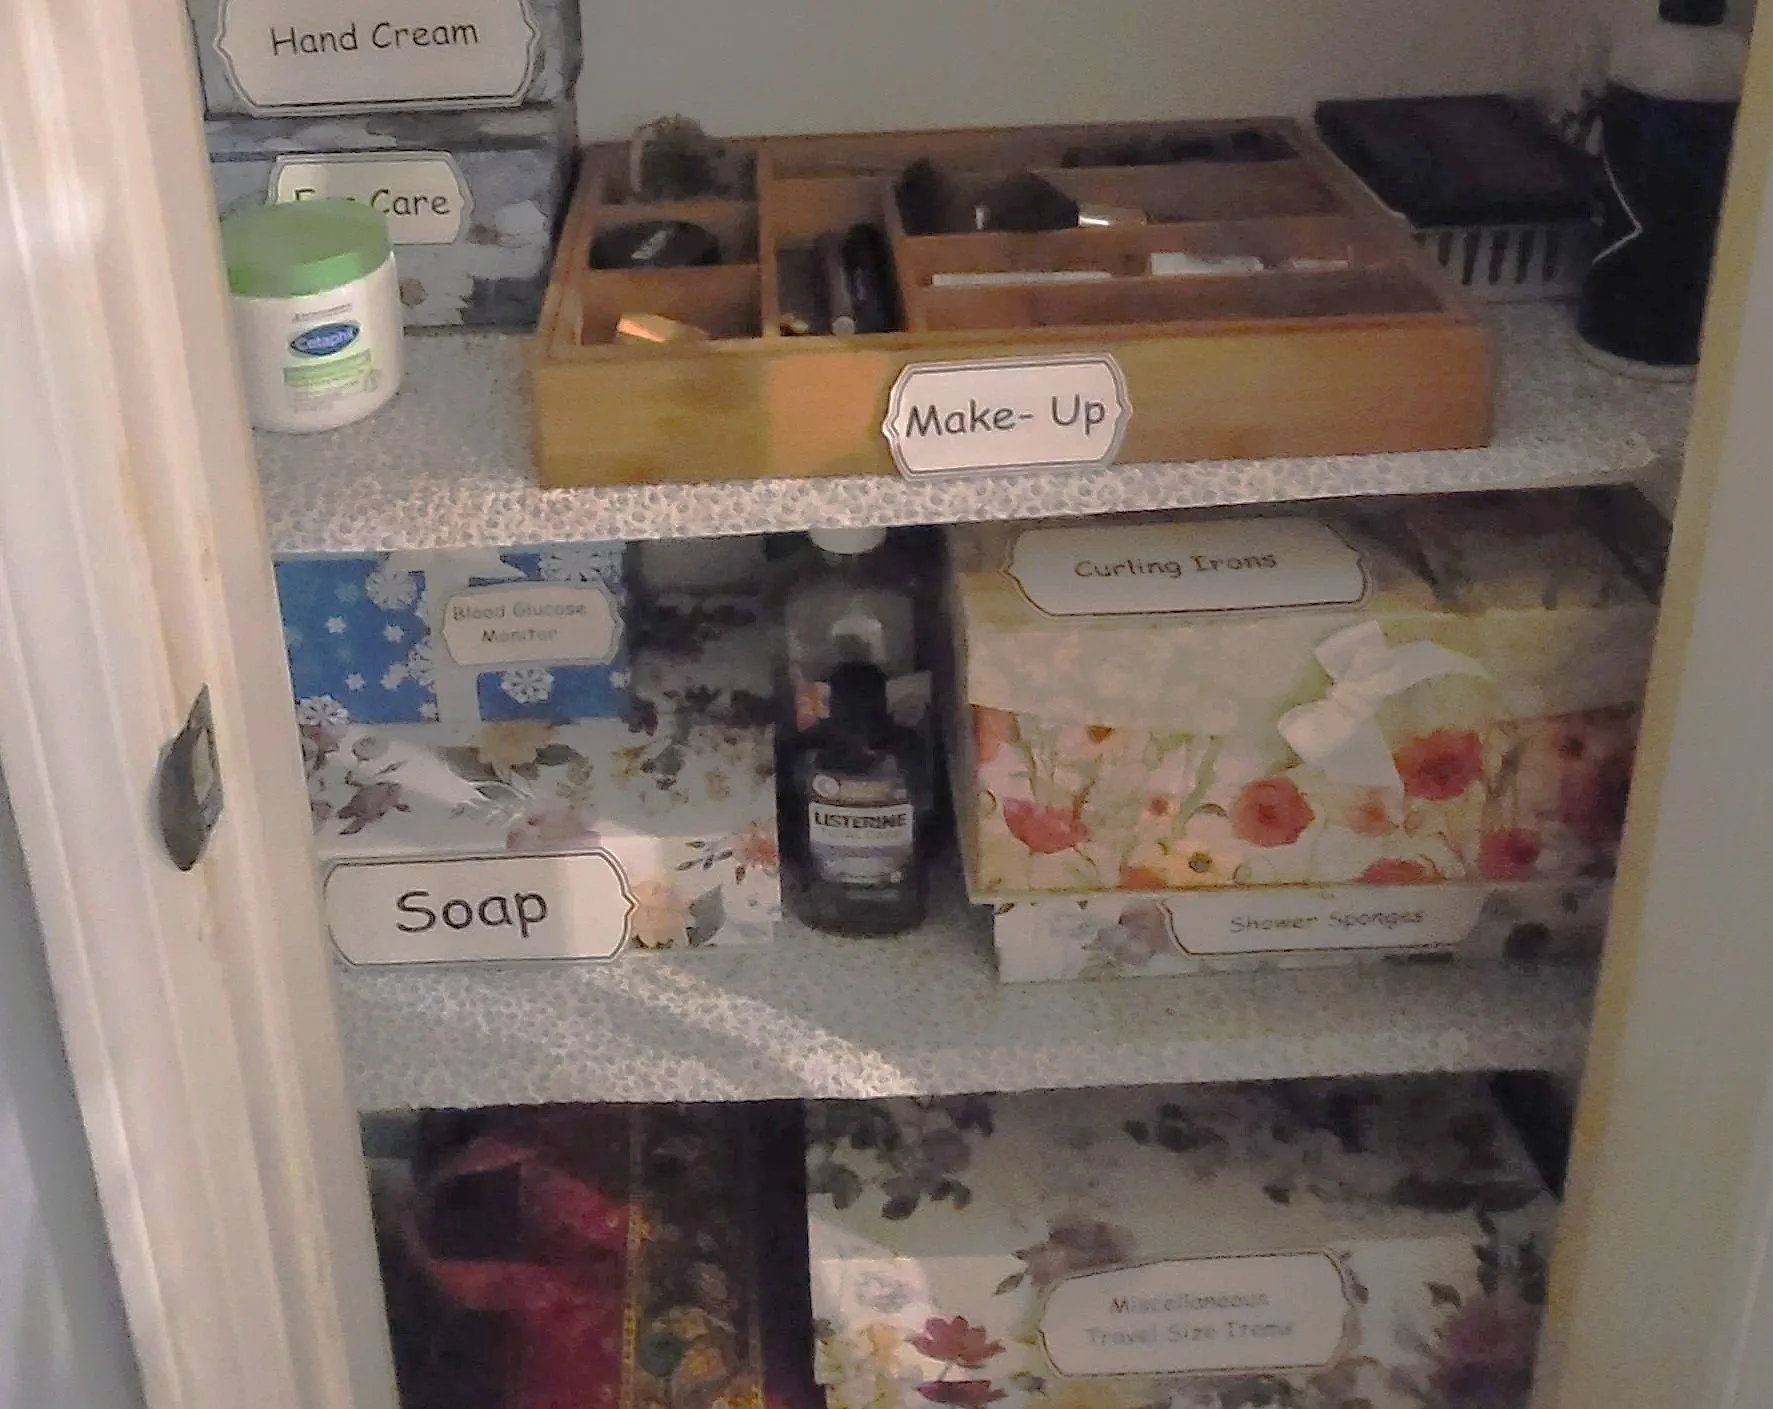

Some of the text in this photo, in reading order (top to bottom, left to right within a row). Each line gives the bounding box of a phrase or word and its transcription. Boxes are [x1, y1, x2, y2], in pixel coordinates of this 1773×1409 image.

[269, 20, 480, 58] Hand Cream
[370, 187, 452, 217] Care
[905, 392, 1106, 439] Make- Up
[1073, 550, 1278, 581] Curling Irons
[452, 604, 506, 622] Blood
[814, 811, 908, 830] LISTERINE
[395, 888, 549, 938] Soap
[1229, 915, 1319, 934] Shower
[1167, 1322, 1217, 1343] Size
